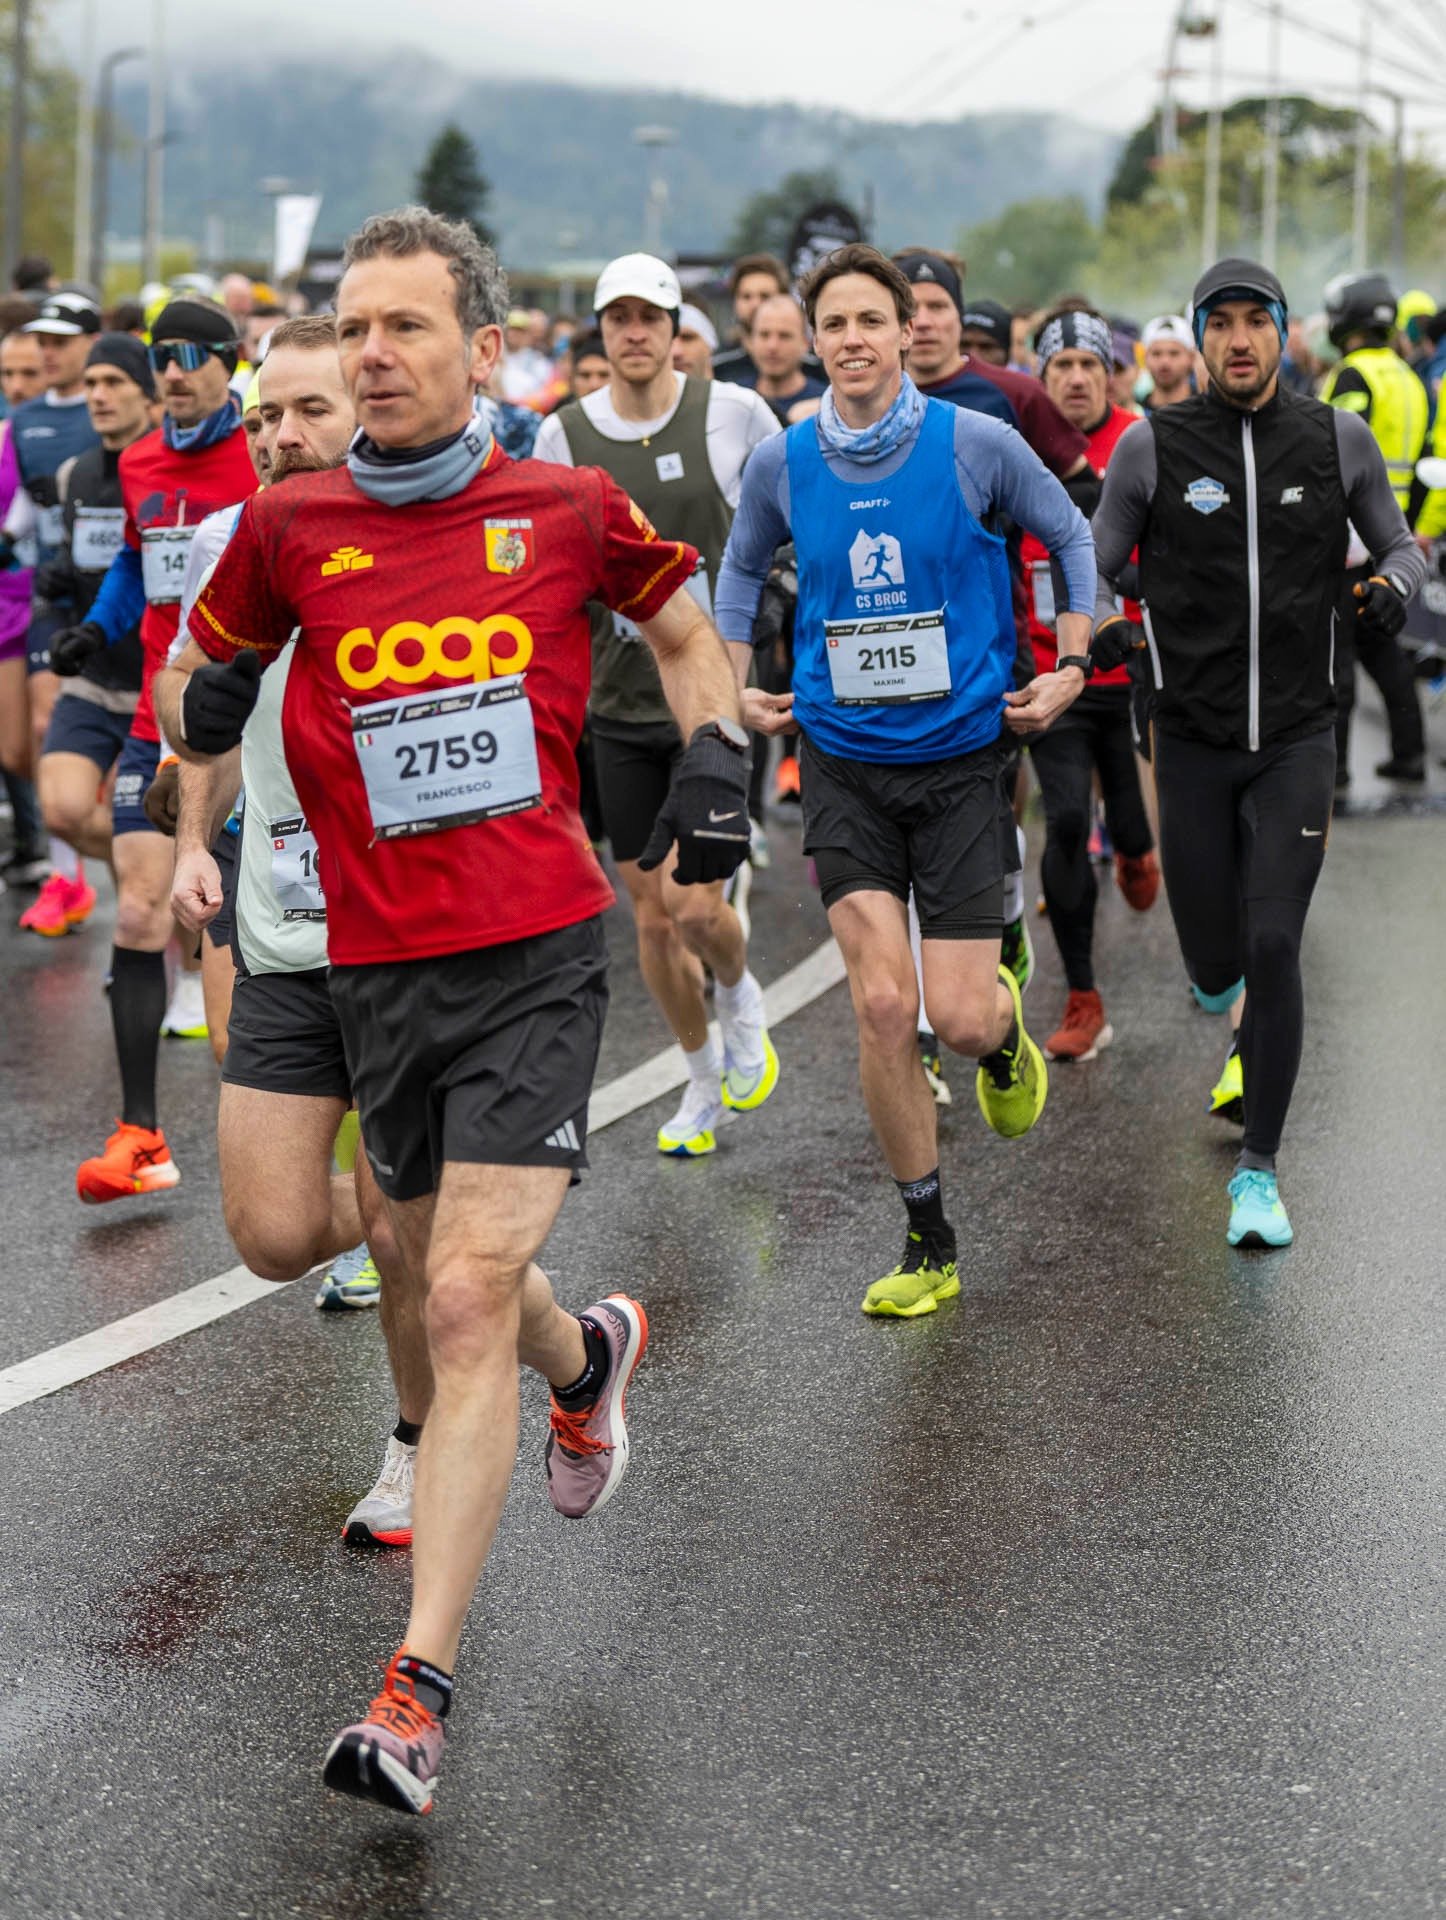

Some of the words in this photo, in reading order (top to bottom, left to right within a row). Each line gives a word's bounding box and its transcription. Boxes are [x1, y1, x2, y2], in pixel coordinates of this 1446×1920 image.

[849, 498, 882, 510] CRAFT
[855, 594, 872, 609] CS
[874, 590, 907, 607] BROC
[336, 613, 534, 691] coop
[858, 644, 916, 671] 2115
[873, 678, 906, 687] MAXIME
[395, 730, 498, 780] 2759
[417, 780, 493, 804] FRANCESCO
